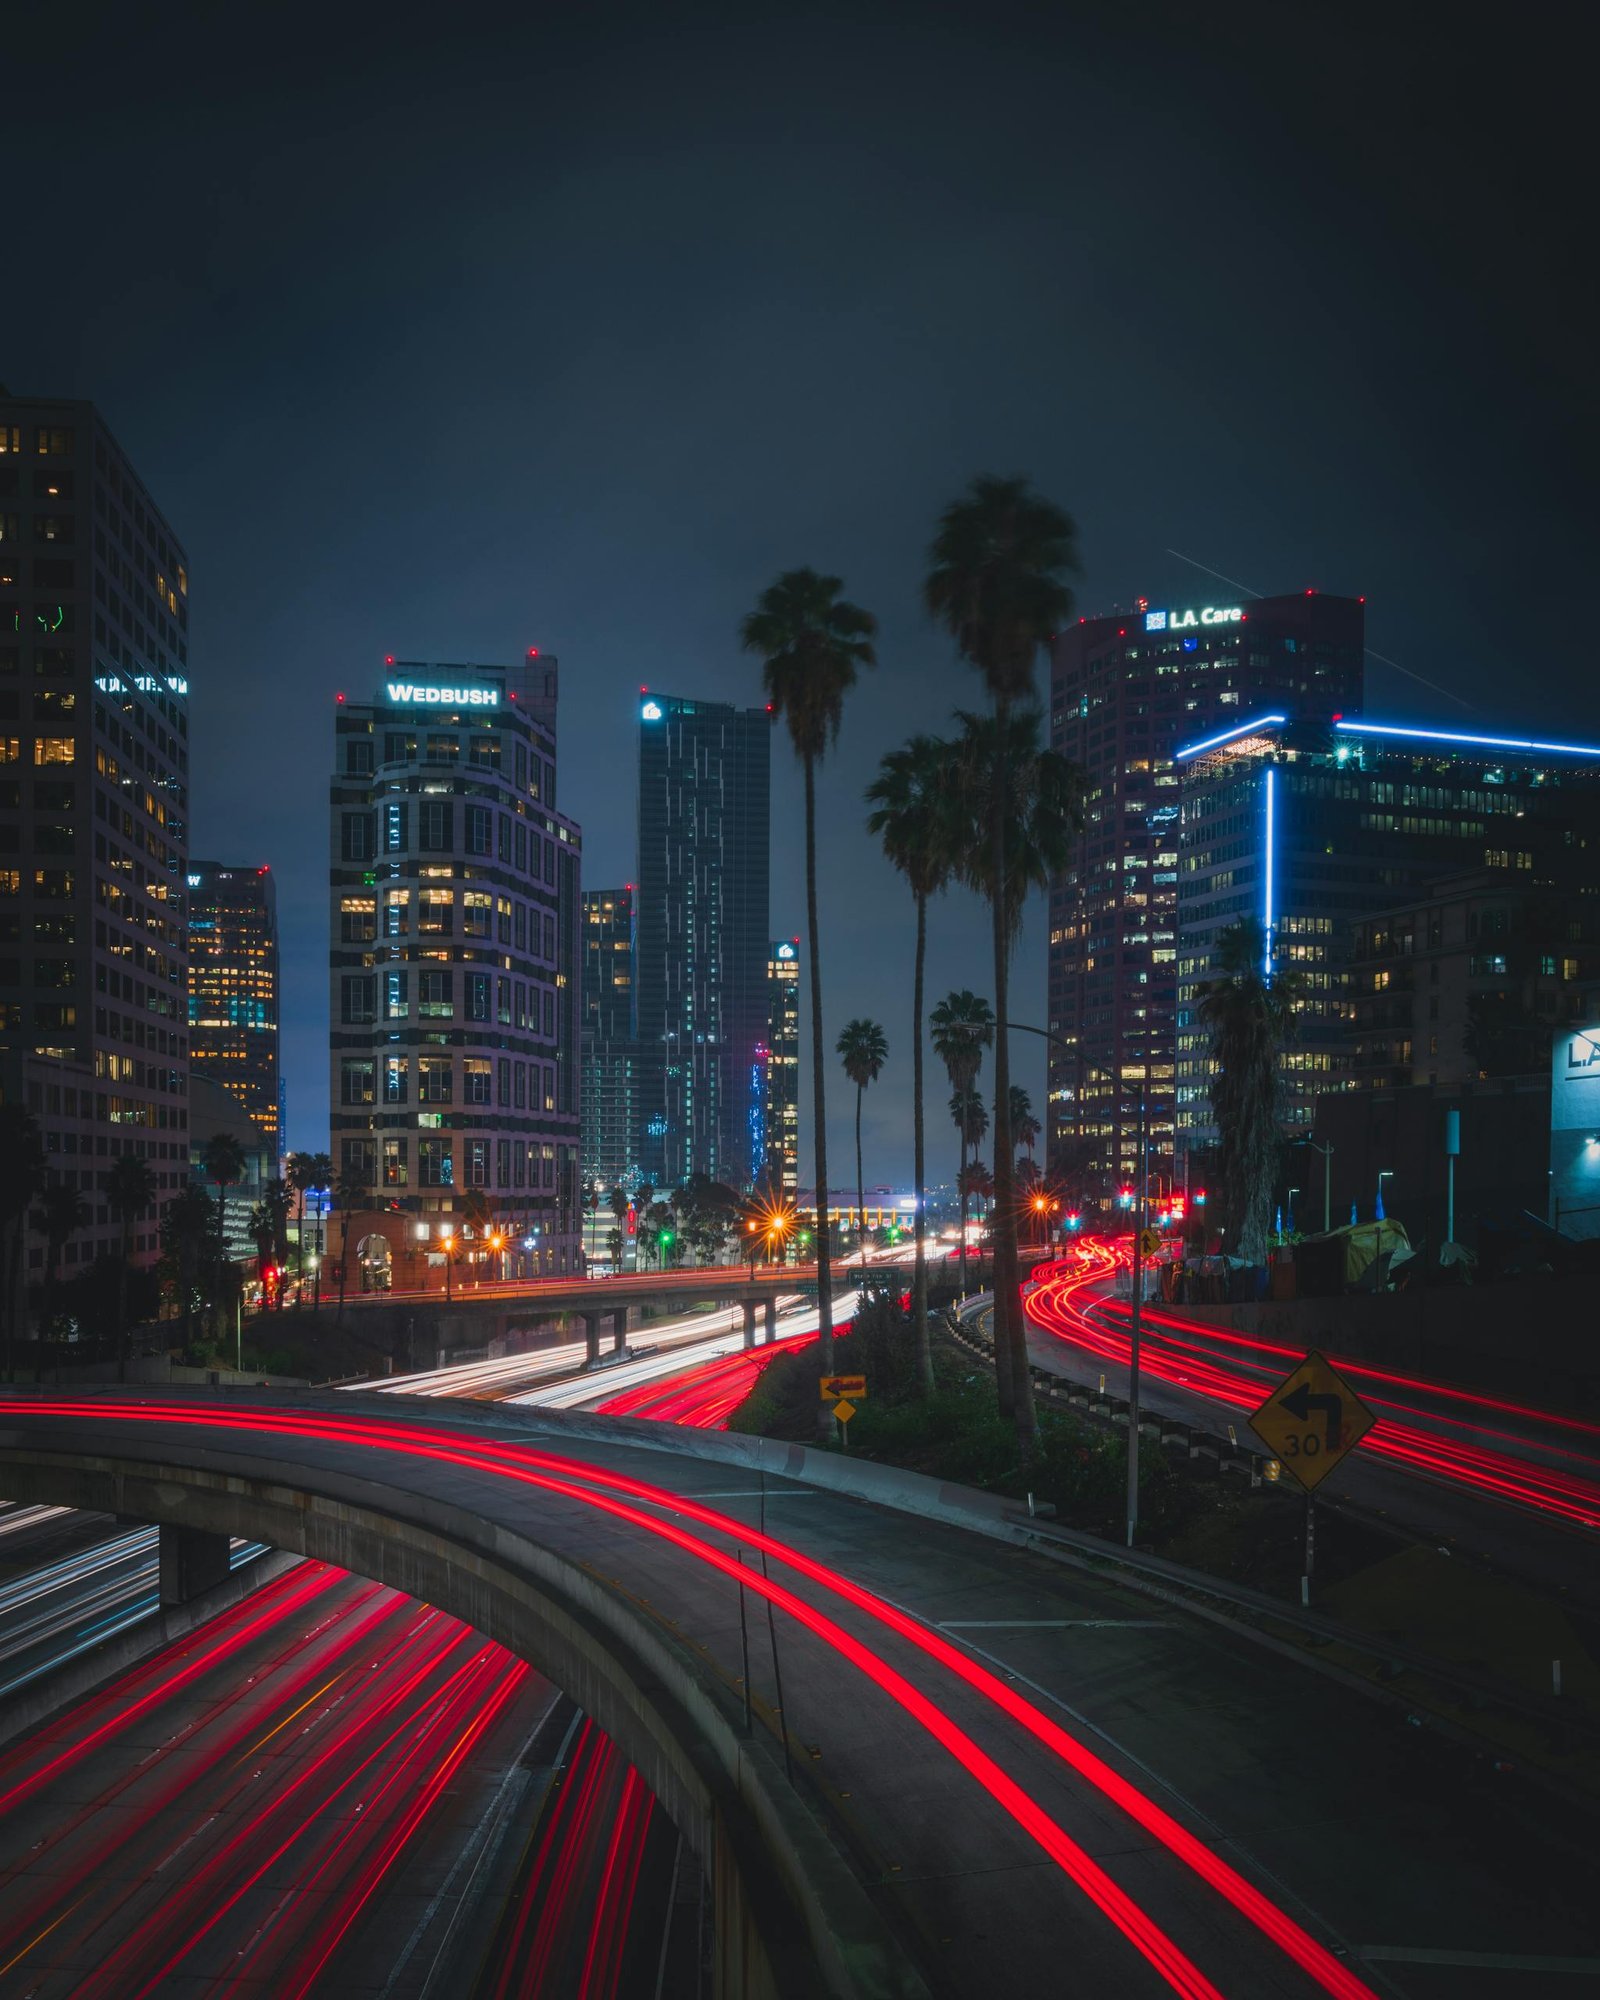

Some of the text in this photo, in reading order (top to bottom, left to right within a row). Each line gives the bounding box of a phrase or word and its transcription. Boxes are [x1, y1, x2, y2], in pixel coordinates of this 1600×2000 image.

[1169, 607, 1242, 629] L.A. Care
[387, 684, 497, 705] WEDBUSH
[1284, 1433, 1320, 1457] 30
